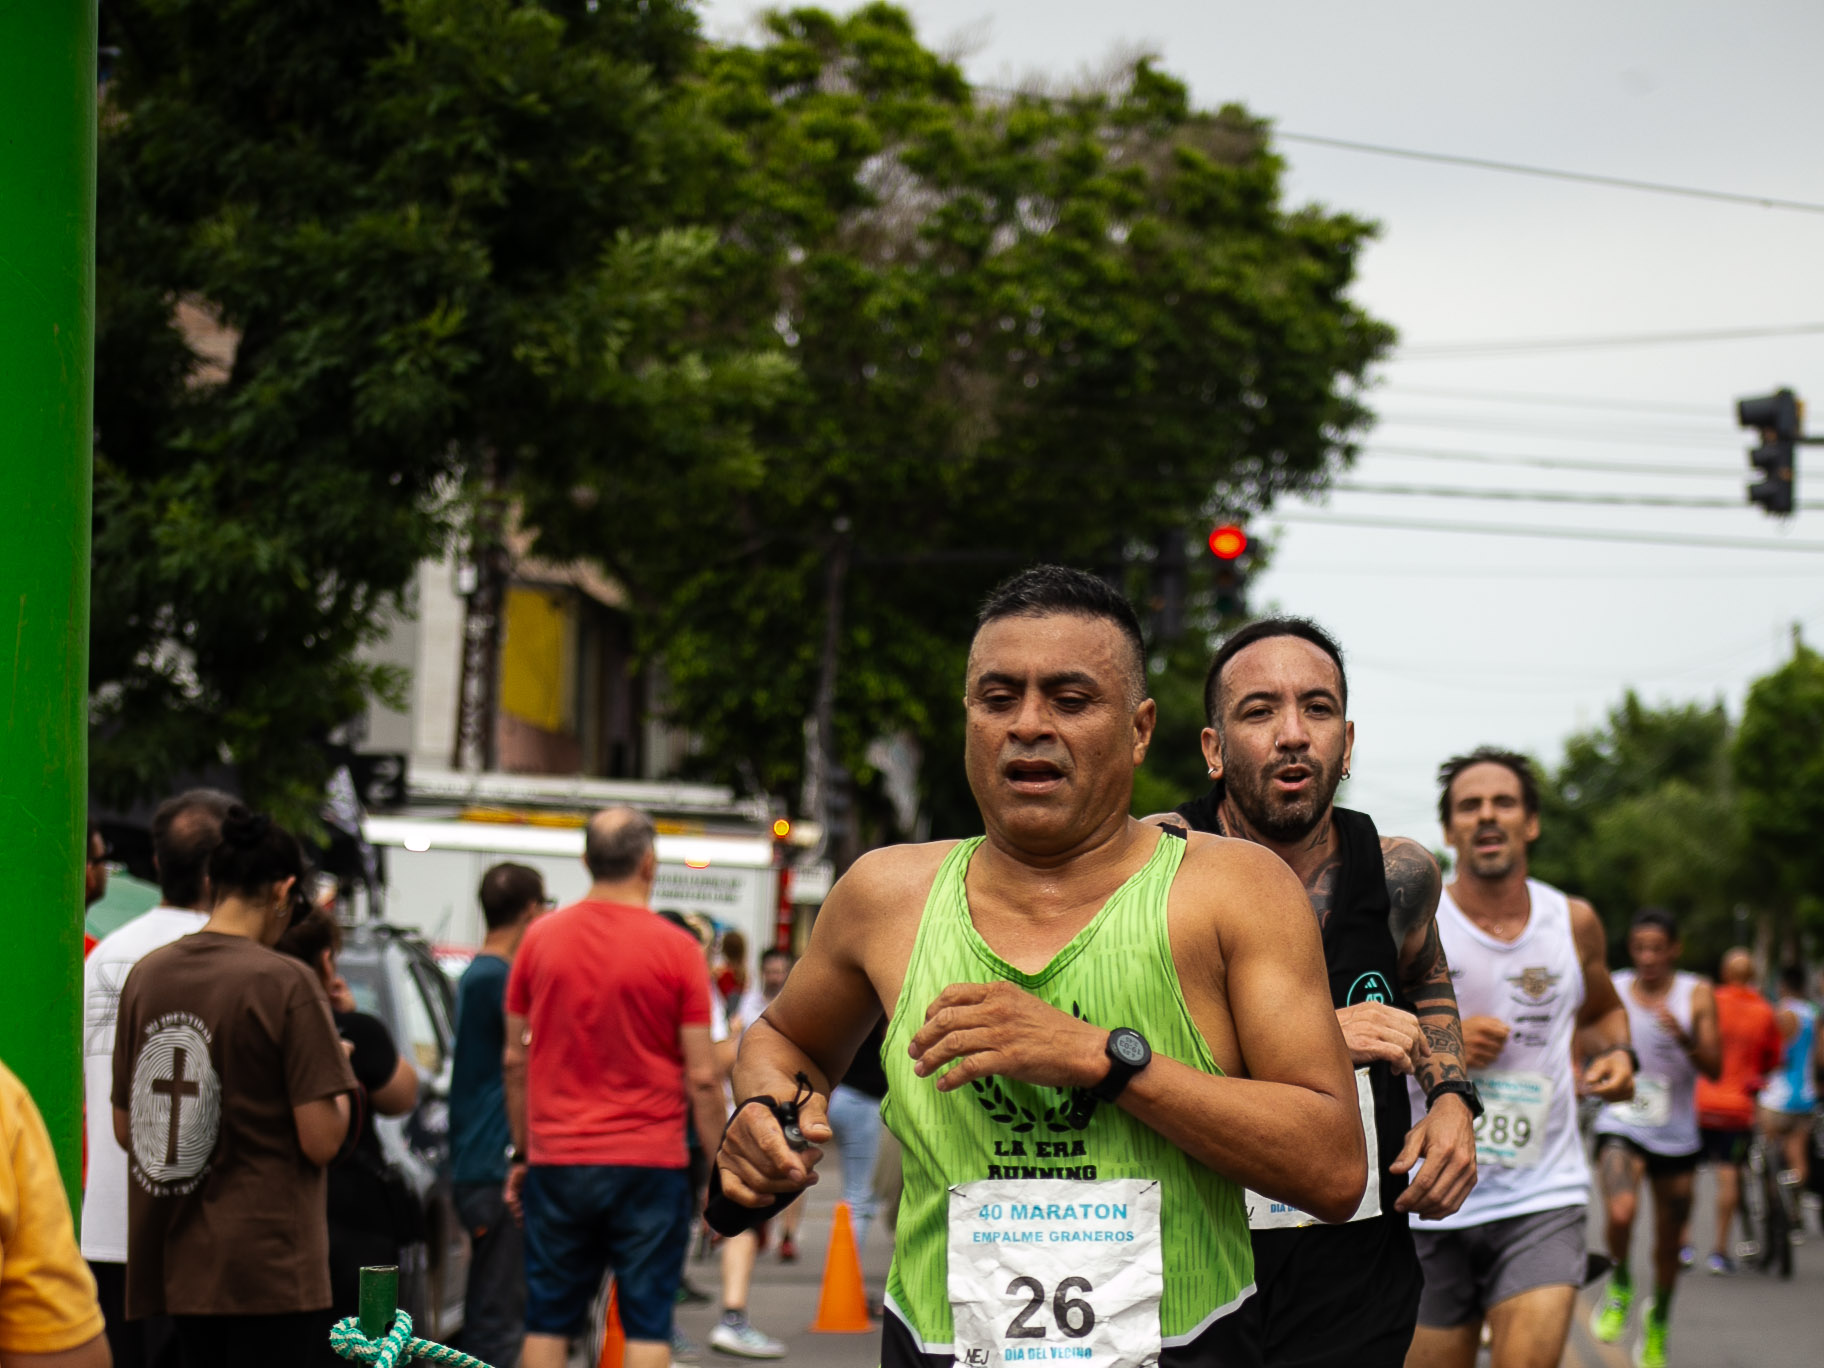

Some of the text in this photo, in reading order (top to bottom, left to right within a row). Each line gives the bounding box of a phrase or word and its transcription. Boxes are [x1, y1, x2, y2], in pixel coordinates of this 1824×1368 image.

[1474, 1113, 1531, 1147] 289
[994, 1140, 1087, 1157] LA ERA
[987, 1164, 1097, 1180] RUNNING
[979, 1204, 1127, 1220] 40 MARATON
[1270, 1203, 1286, 1213] DIA
[973, 1230, 1134, 1243] EMPALME GRANEROS
[1004, 1276, 1095, 1339] 26
[1005, 1346, 1092, 1361] DIA DEL VECINO
